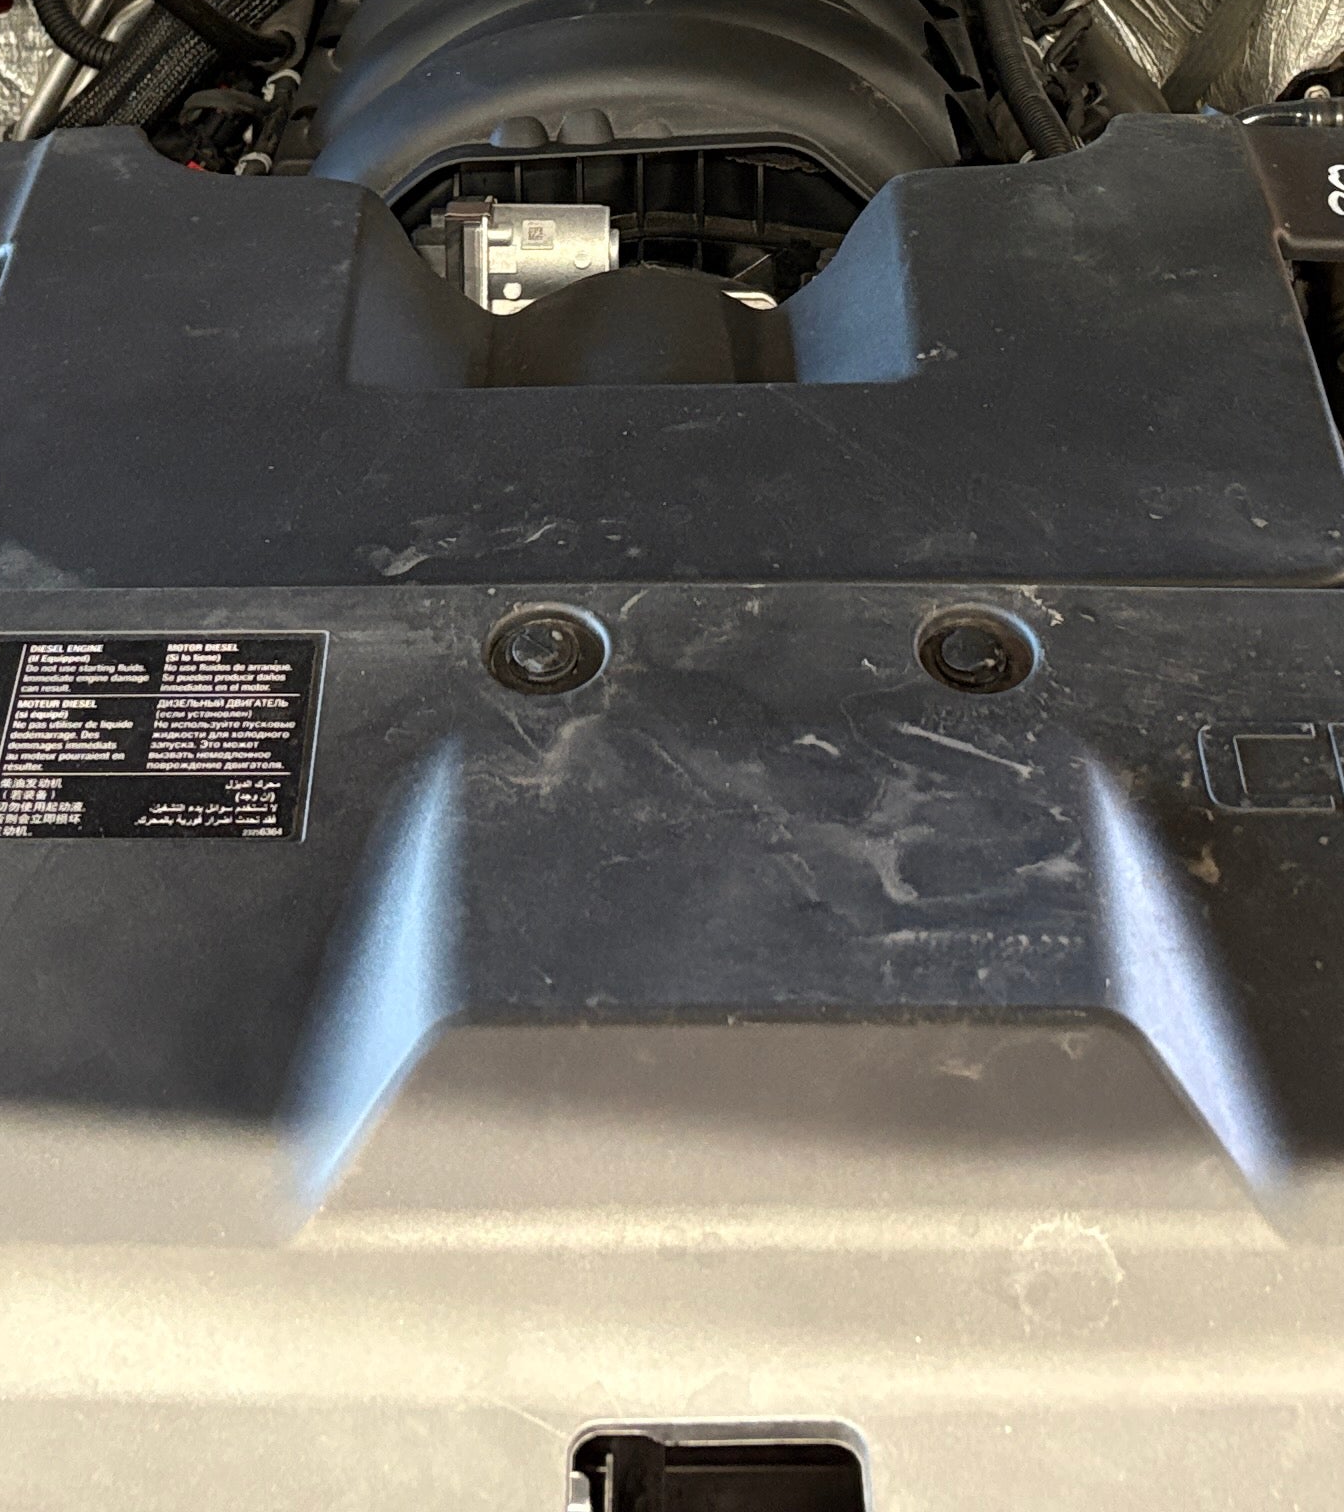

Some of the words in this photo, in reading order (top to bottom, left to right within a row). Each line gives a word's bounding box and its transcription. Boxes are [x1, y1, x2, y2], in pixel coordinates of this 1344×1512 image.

[30, 644, 65, 653] DIESEL
[66, 644, 104, 653] ENGINE
[167, 643, 203, 652] MOTOR
[204, 643, 239, 652] DIESEL
[40, 654, 91, 664] Equipped)
[25, 664, 39, 673] Do
[40, 664, 57, 673] not
[78, 664, 116, 674] starting
[163, 664, 177, 672] No
[198, 663, 231, 671] fluidos
[233, 663, 246, 671] de
[247, 664, 293, 673] arranque.
[22, 675, 74, 683] Immediate
[76, 675, 109, 684] engine
[110, 674, 150, 683] damage
[162, 674, 175, 682] Se
[176, 674, 213, 683] pueden
[214, 674, 255, 683] producir
[40, 684, 72, 693] result.
[159, 684, 213, 692] inmediatos
[240, 684, 272, 692] motor.
[17, 700, 60, 709] MOTEUR
[62, 700, 98, 709] DIESEL
[157, 698, 225, 708] ДИЗЕЛЬНЫЙ
[226, 698, 289, 708] ДВИГАТЕЛЬ
[15, 710, 28, 719] (si
[156, 710, 186, 719] (если
[187, 710, 253, 720] установлен)
[12, 720, 27, 729] Ne
[28, 722, 47, 730] pas
[48, 720, 83, 729] utiliser
[85, 720, 98, 728] de
[99, 720, 134, 730] liquide
[154, 720, 169, 729] Не
[170, 720, 241, 730] используйте
[242, 721, 296, 730] пусковые
[80, 730, 100, 739] Des
[152, 731, 207, 739] жидкости
[208, 731, 230, 740] для
[231, 731, 290, 739] холодного
[7, 741, 63, 751] dommages
[150, 741, 197, 750] запуска.
[199, 740, 221, 748] Это
[222, 741, 260, 749] может
[20, 752, 57, 760] moteur
[58, 752, 110, 762] pourraient
[146, 762, 223, 771] повреждение
[224, 761, 285, 770] двигателя.
